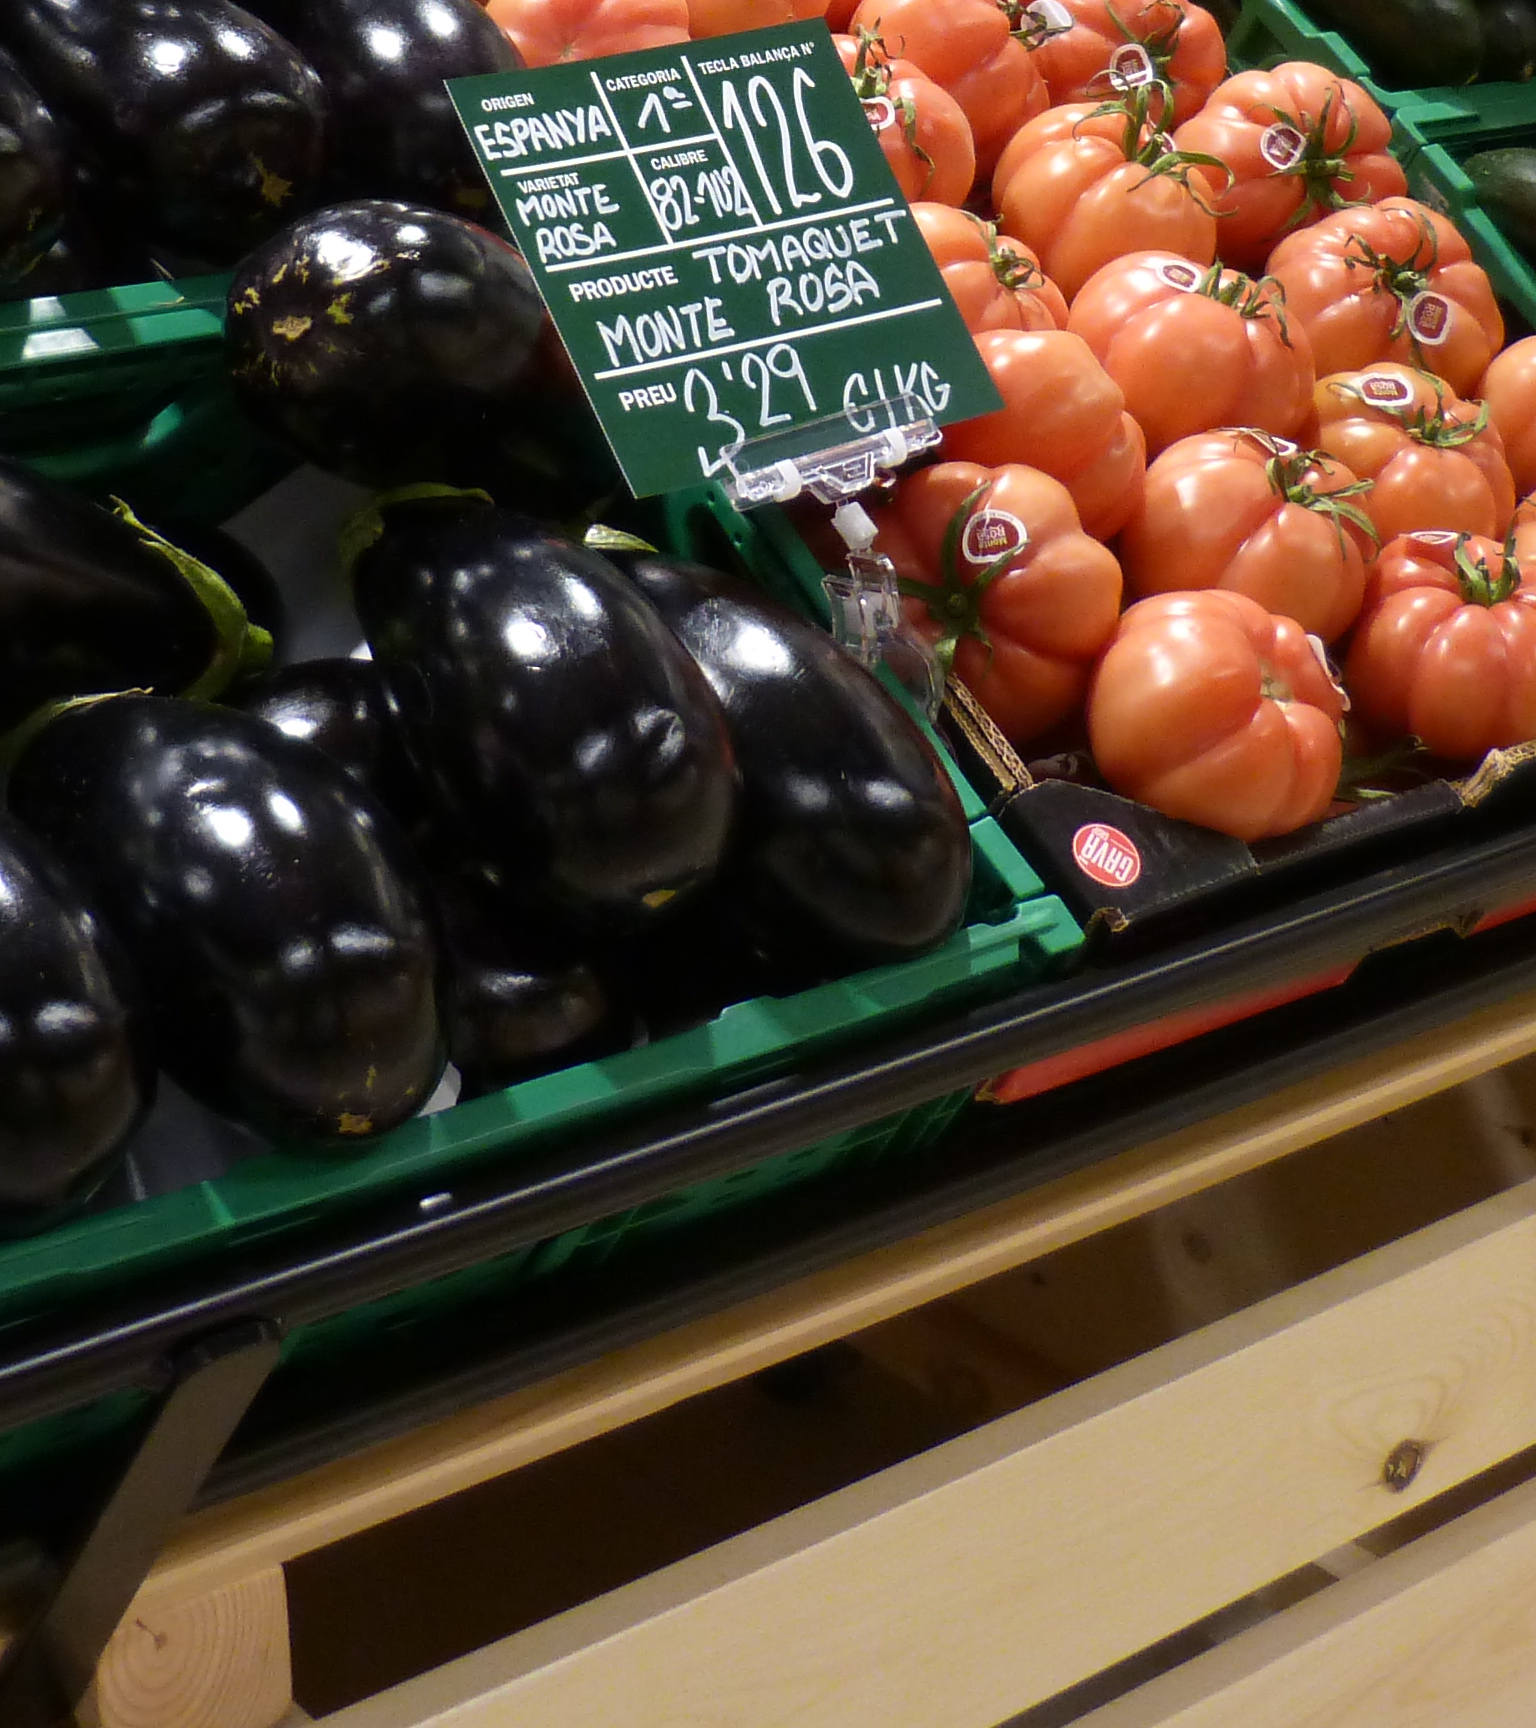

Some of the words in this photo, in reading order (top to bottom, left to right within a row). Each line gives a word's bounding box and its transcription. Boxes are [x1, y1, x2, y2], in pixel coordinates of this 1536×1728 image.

[481, 92, 535, 112] ORIGEN
[606, 67, 681, 93] CATEGORIA
[697, 54, 738, 76] TECLA
[739, 47, 799, 71] BALANÇA
[474, 105, 611, 162] ESPANYA
[651, 149, 708, 171] CALIBRE
[721, 67, 854, 215] 126
[515, 184, 620, 227] MONTE
[517, 171, 580, 193] VARIETAT
[651, 163, 752, 232] 82-102
[535, 222, 617, 265] ROSA
[568, 266, 679, 303] PRODUCTE
[692, 210, 906, 284] TOMAQUET
[596, 296, 735, 368] MONTE
[766, 261, 879, 327] ROSA
[618, 382, 677, 412] PREU
[684, 343, 816, 477] 3'29
